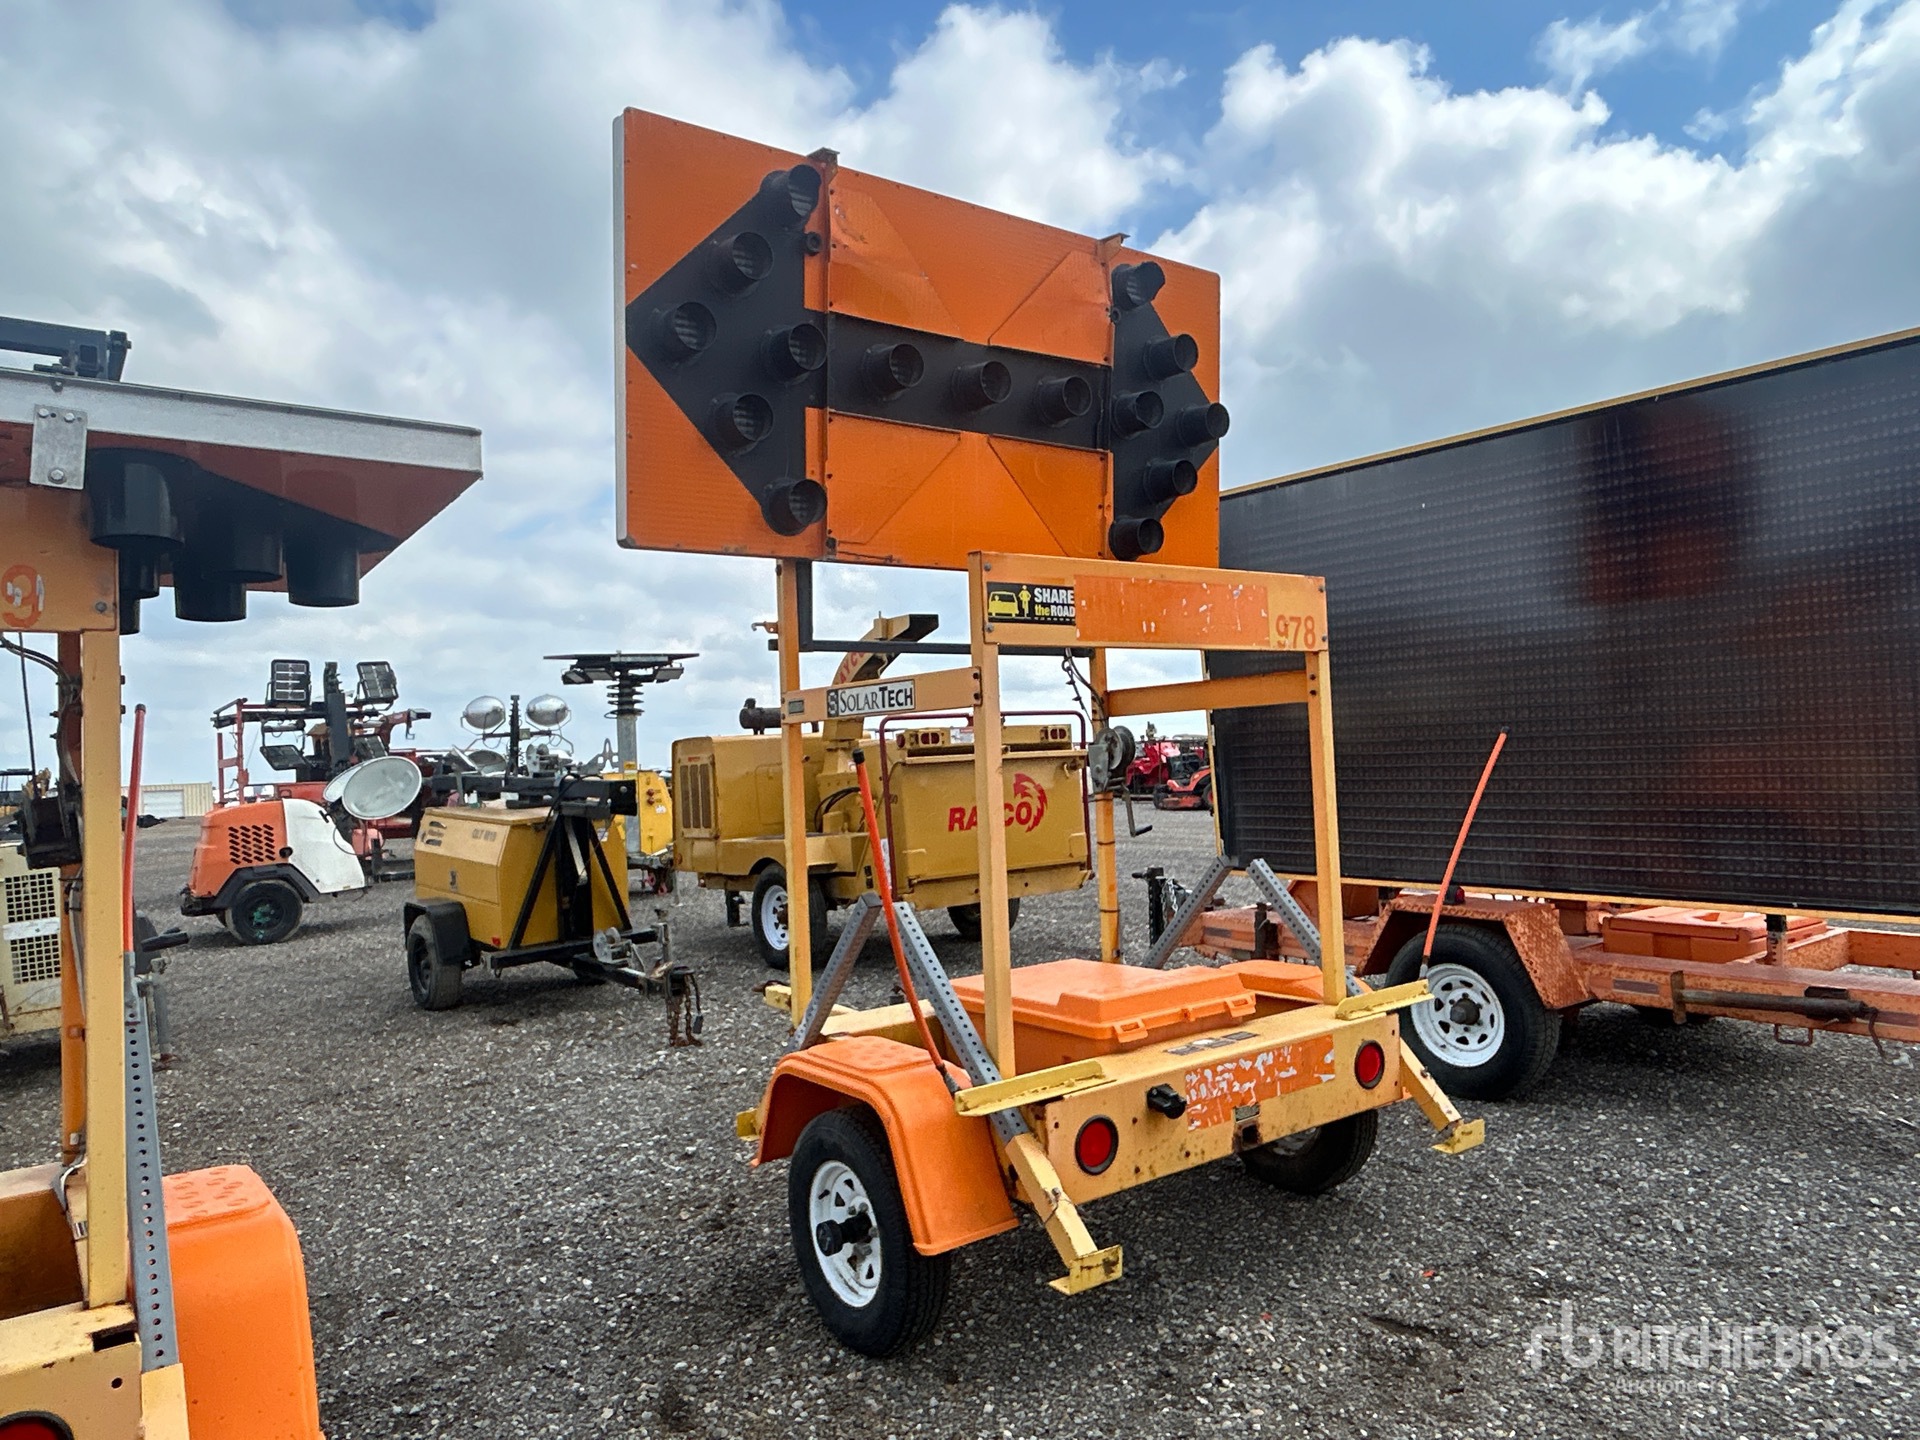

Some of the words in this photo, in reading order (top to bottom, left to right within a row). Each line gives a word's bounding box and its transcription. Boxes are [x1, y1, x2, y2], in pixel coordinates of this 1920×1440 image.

[1034, 587, 1075, 604] SHARE
[1035, 604, 1050, 616] the
[1050, 605, 1076, 617] ROAD
[1276, 614, 1316, 649] 978
[948, 801, 1032, 832] RACO
